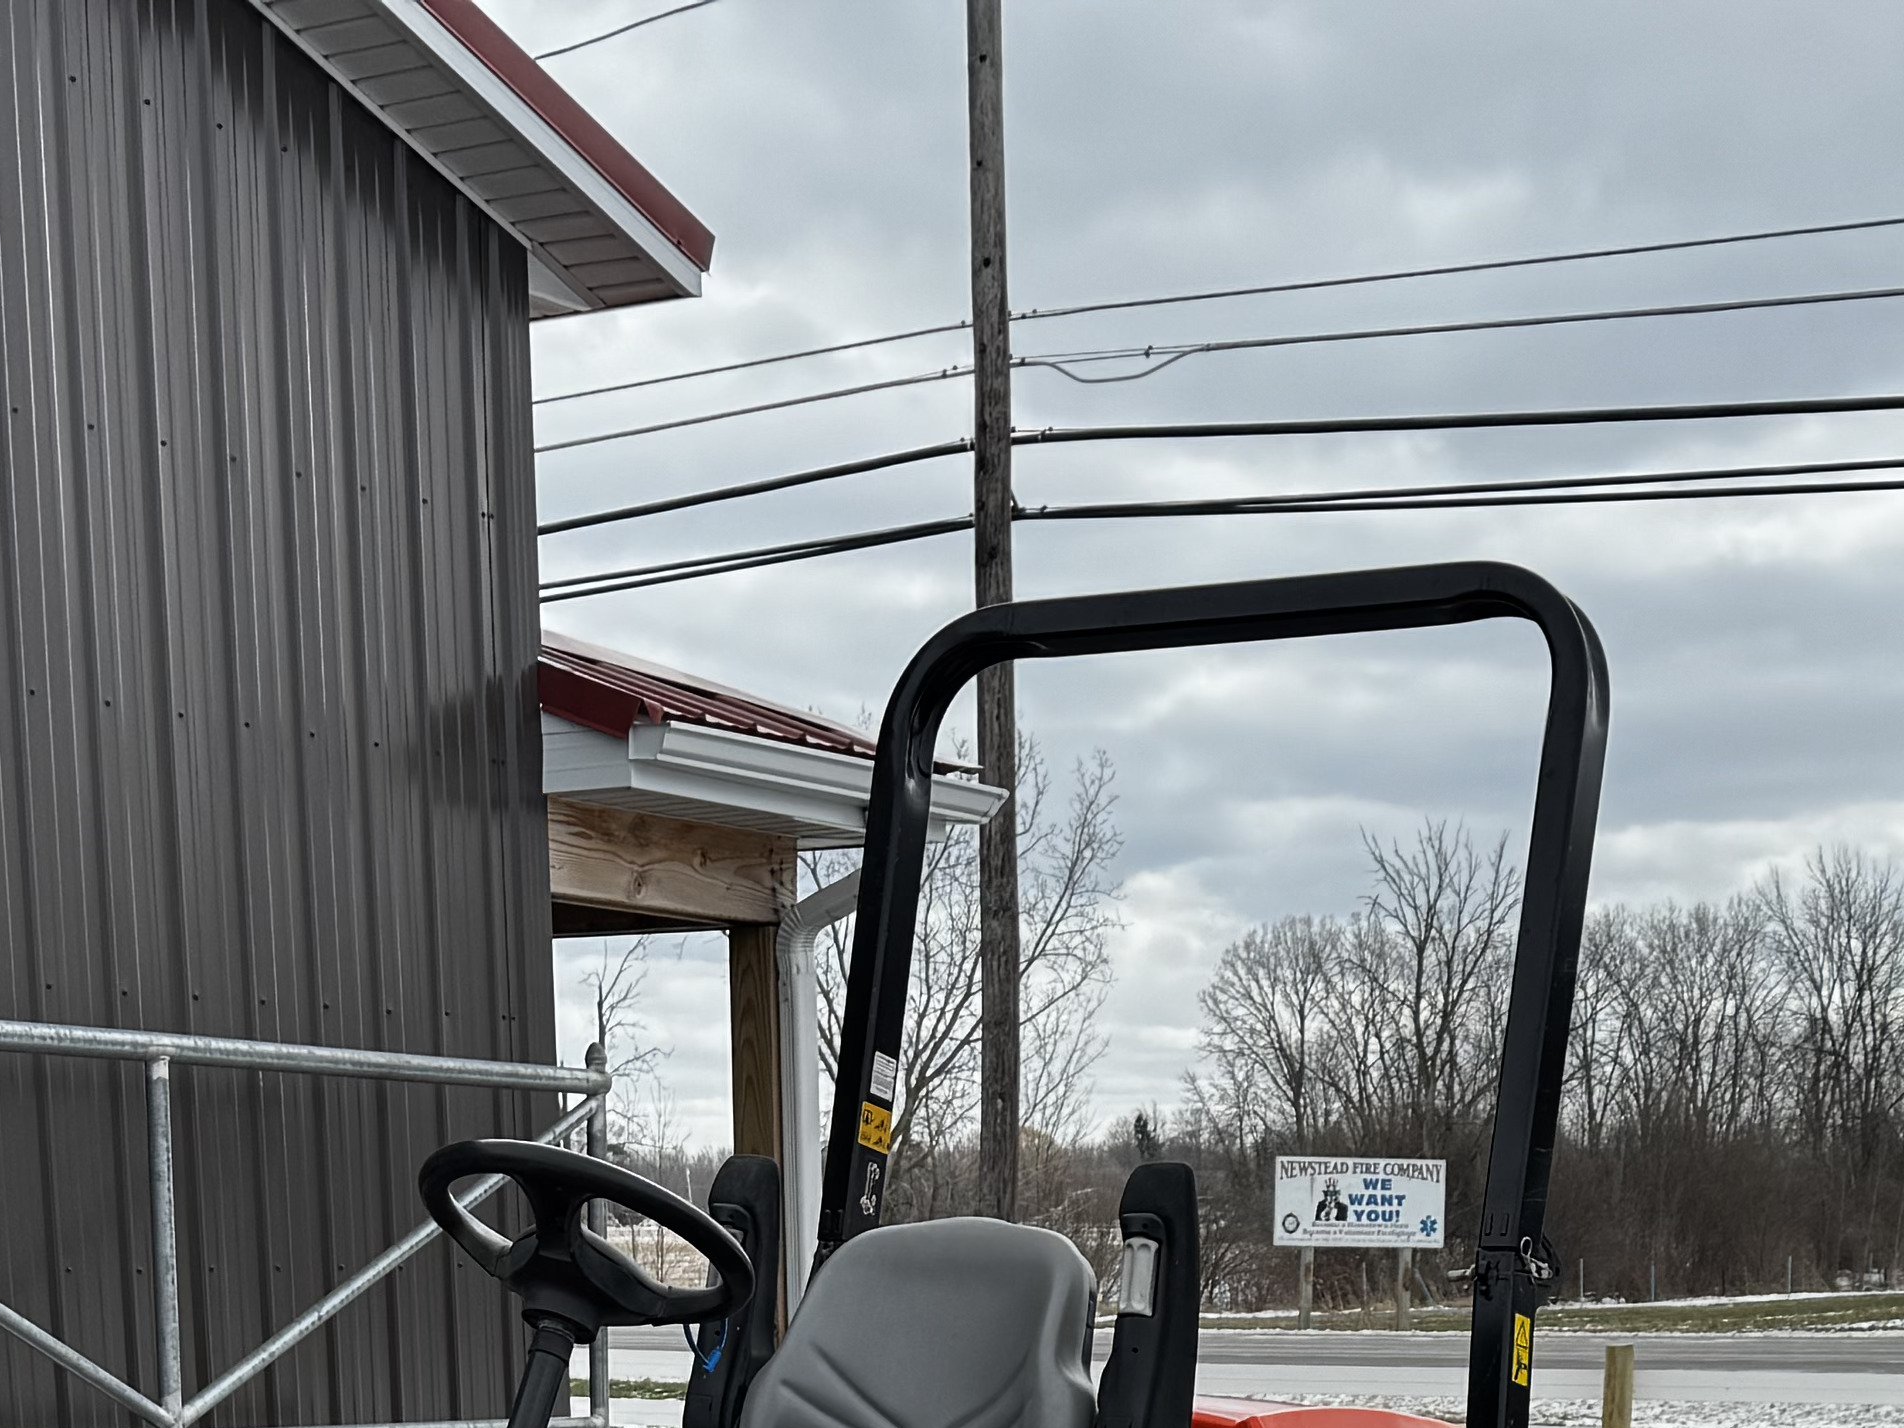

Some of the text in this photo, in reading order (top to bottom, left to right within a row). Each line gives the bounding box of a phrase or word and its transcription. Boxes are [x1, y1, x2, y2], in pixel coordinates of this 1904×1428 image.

[1280, 1160, 1442, 1183] NEWSTEAD FIRE COMPANY
[1362, 1178, 1393, 1191] WE
[1348, 1193, 1406, 1207] WANT
[1353, 1209, 1401, 1223] YOU!
